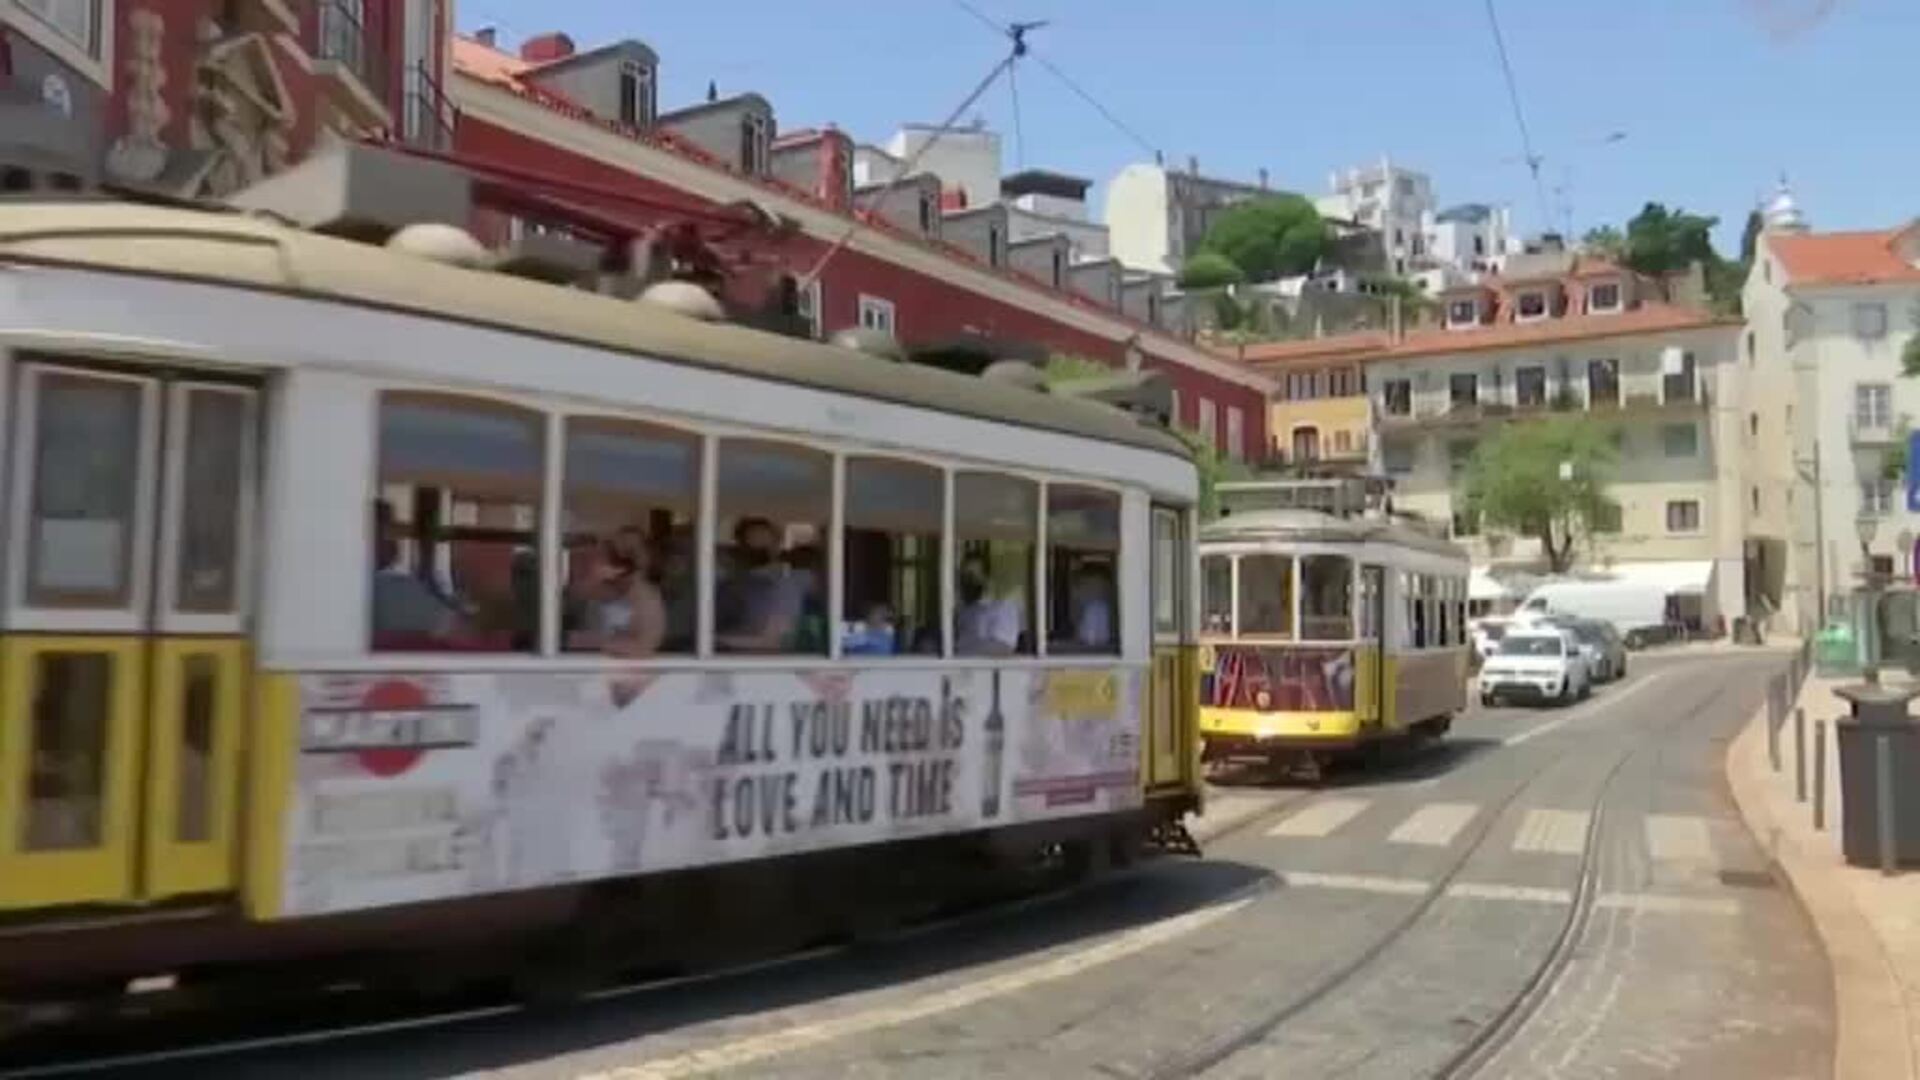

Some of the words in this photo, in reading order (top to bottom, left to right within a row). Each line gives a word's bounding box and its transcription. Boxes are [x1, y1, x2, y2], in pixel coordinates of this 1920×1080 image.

[718, 702, 776, 765] ALL
[790, 700, 850, 758] YOU
[862, 694, 931, 753] NEED
[712, 772, 798, 841] LOVE
[809, 765, 876, 829] AND
[887, 759, 955, 818] TIME
